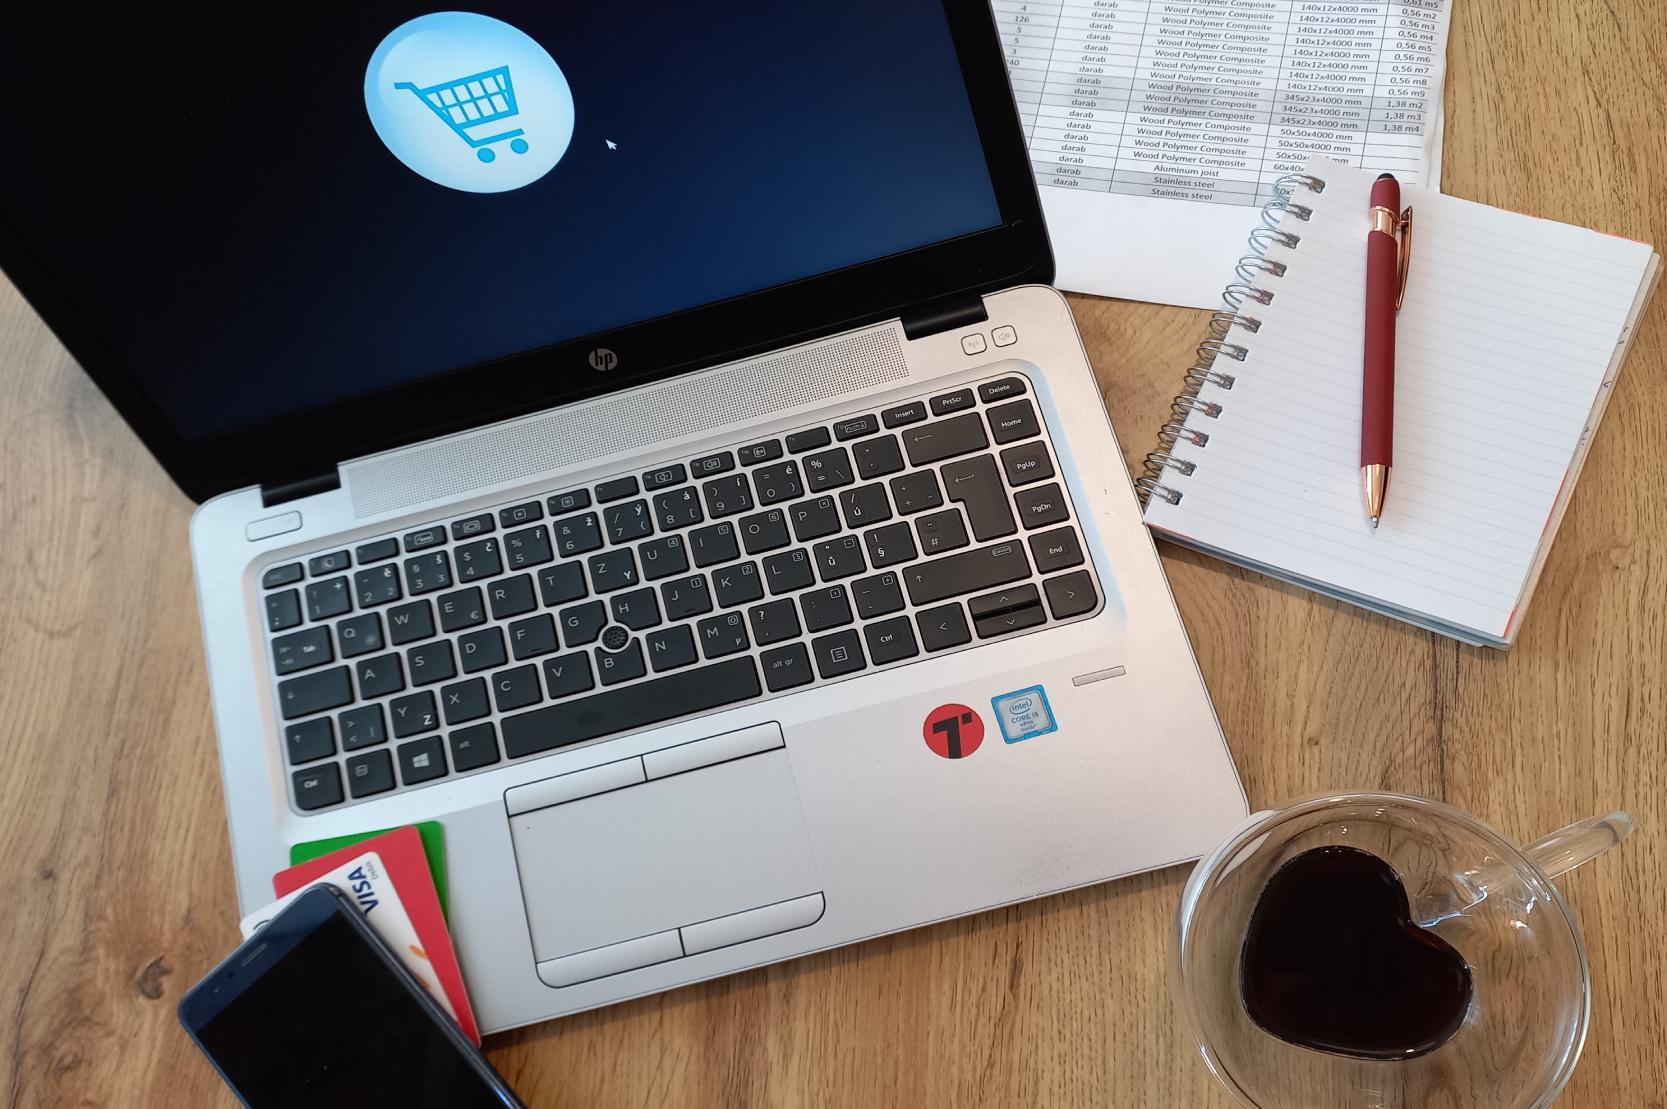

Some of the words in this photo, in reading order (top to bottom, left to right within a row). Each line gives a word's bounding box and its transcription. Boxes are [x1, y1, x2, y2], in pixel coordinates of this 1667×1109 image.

[1164, 6, 1189, 14] Wood
[1192, 8, 1226, 16] Polymer
[1229, 11, 1274, 20] Composite
[1190, 19, 1224, 28] Polymer
[1226, 22, 1272, 31] Composite
[1089, 22, 1113, 30] darab
[1187, 30, 1221, 39] Polymer
[1224, 33, 1269, 42] Composite
[1157, 39, 1182, 47] Wood
[1185, 41, 1219, 50] Polymer
[1222, 44, 1267, 53] Composite
[1183, 52, 1217, 61] Polymer
[1220, 55, 1265, 64] Composite
[1153, 61, 1178, 69] Wood
[1180, 63, 1214, 72] Polymer
[1218, 66, 1263, 75] Composite
[1150, 72, 1175, 80] Wood
[1178, 74, 1212, 83] Polymer
[1216, 77, 1261, 86] Composite
[1077, 77, 1101, 85] darab
[1176, 85, 1210, 94] Polymer
[1213, 88, 1259, 97] Composite
[1145, 94, 1170, 102] Wood
[1174, 96, 1208, 105] Polymer
[1211, 99, 1257, 108] Composite
[1072, 99, 1096, 107] darab
[1143, 105, 1168, 113] Wood
[1171, 107, 1206, 116] Polymer
[1209, 110, 1254, 120] Composite
[1069, 110, 1093, 118] darab
[1140, 116, 1165, 125] Wood
[1168, 119, 1202, 128] Polymer
[1205, 122, 1251, 132] Composite
[1137, 128, 1163, 136] Wood
[1165, 130, 1200, 139] Polymer
[1203, 133, 1249, 143] Composite
[1064, 133, 1088, 141] darab
[1135, 139, 1160, 148] Wood
[1163, 142, 1197, 151] Polymer
[1200, 145, 1246, 155] Composite
[1062, 144, 1086, 152] darab
[1134, 151, 1159, 159] Wood
[1162, 154, 1197, 163] Polymer
[1199, 157, 1245, 167] Composite
[1154, 165, 1198, 175] Aluminum
[1056, 167, 1081, 175] darab
[1153, 177, 1191, 186] Stainless
[1054, 178, 1078, 186] darab
[1152, 188, 1188, 198] Stainless
[591, 348, 615, 371] hp
[988, 384, 1010, 394] Delete
[942, 396, 963, 405] PrtScr
[894, 409, 915, 418] Insert
[1001, 417, 1022, 428] Home
[1016, 460, 1036, 470] PgUp
[1032, 503, 1051, 513] PgDn
[798, 511, 808, 522] P
[749, 524, 760, 534] O
[646, 550, 658, 560] U
[1049, 546, 1063, 554] End
[597, 562, 608, 574] Z
[771, 565, 781, 575] L
[545, 576, 555, 586] T
[721, 576, 732, 587] K
[495, 590, 506, 600] R
[671, 590, 679, 601] J
[445, 602, 454, 613] E
[618, 602, 630, 613] H
[394, 613, 410, 625] W
[567, 617, 579, 627] G
[516, 630, 526, 640] F
[706, 627, 719, 639] M
[880, 633, 893, 643] Ctrl
[465, 643, 476, 654] D
[655, 641, 667, 652] N
[604, 658, 615, 669] B
[772, 660, 783, 669] alt
[784, 657, 794, 666] gr
[552, 666, 563, 677] V
[500, 681, 511, 691] C
[1011, 700, 1029, 711] intel
[1011, 714, 1031, 724] CORE
[348, 866, 379, 915] VISA
